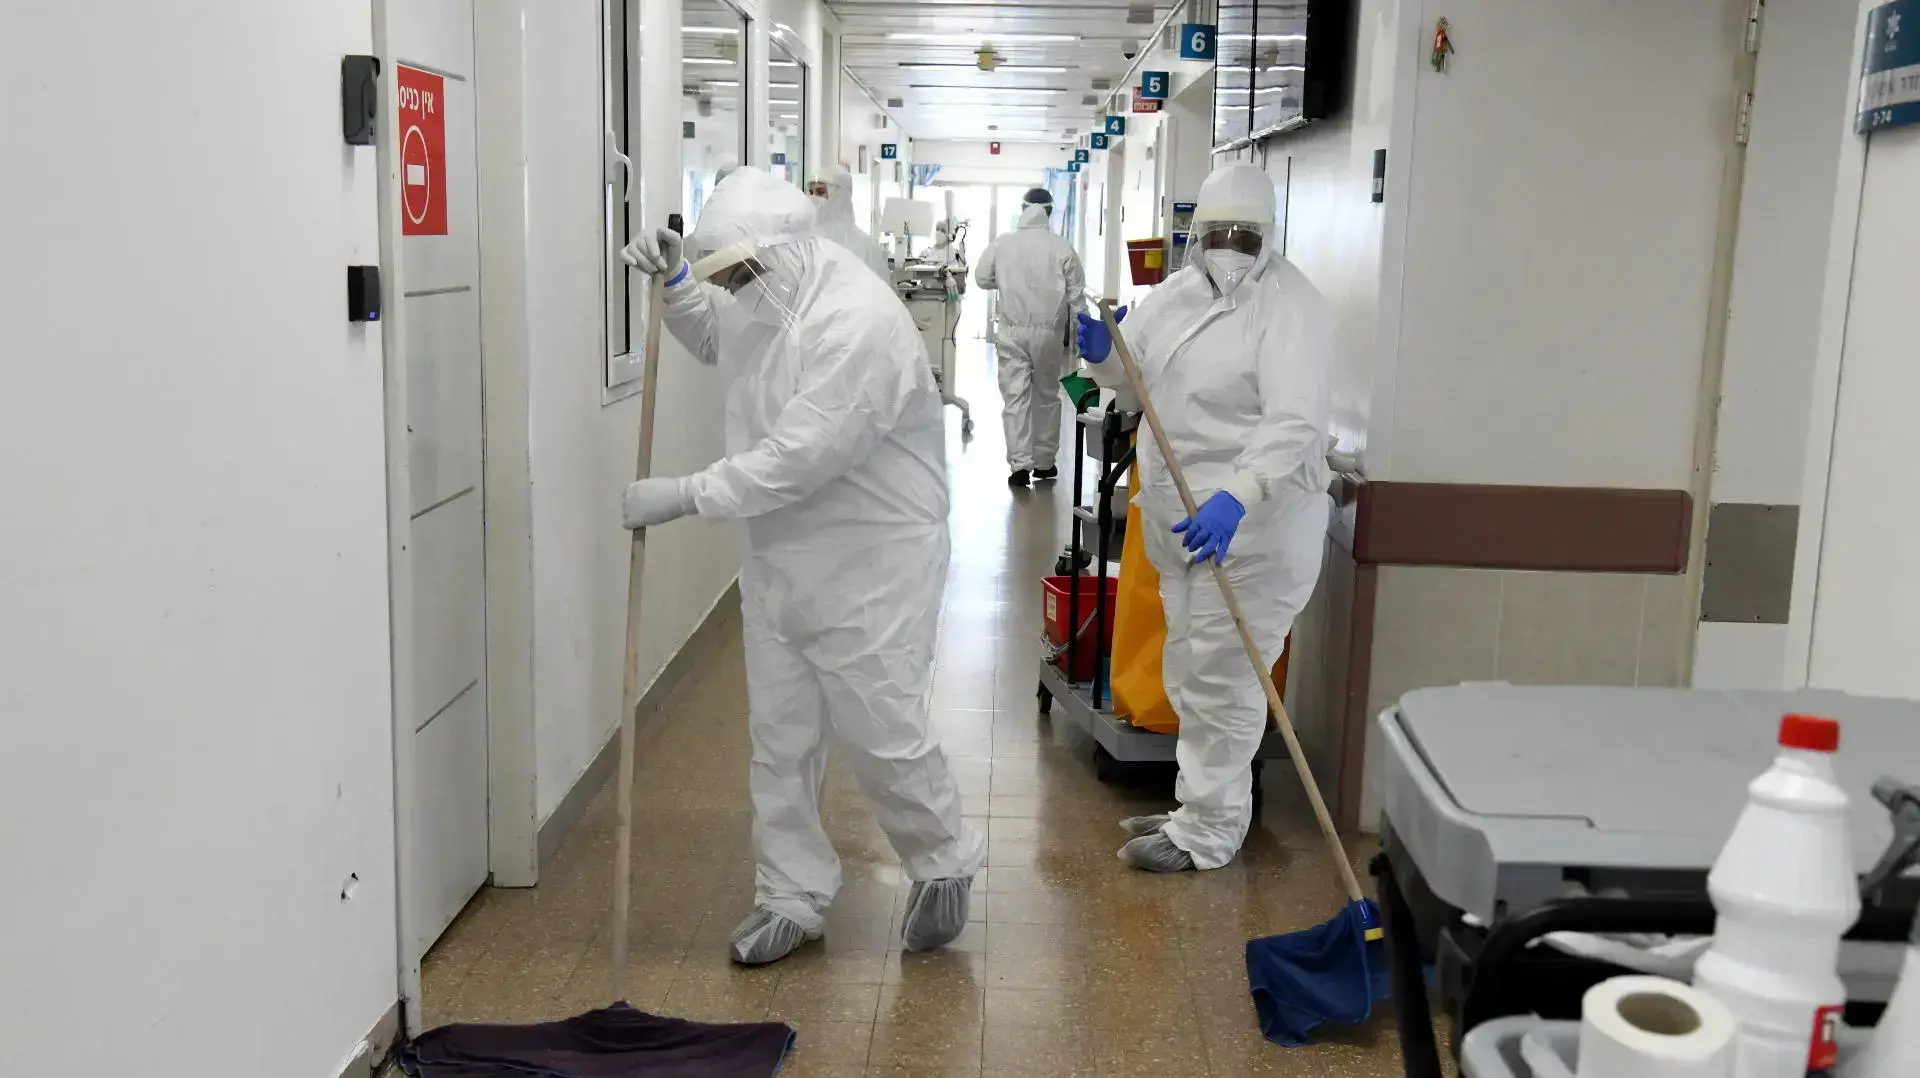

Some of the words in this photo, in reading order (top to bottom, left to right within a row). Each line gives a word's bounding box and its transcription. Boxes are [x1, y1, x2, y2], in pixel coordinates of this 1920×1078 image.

[1191, 31, 1206, 52] 6
[1149, 76, 1161, 93] 5
[396, 85, 419, 111] כניס
[421, 90, 434, 120] אין
[1110, 119, 1120, 132] 4
[1095, 135, 1104, 146] 3
[883, 146, 895, 156] 17
[1078, 151, 1085, 161] 2
